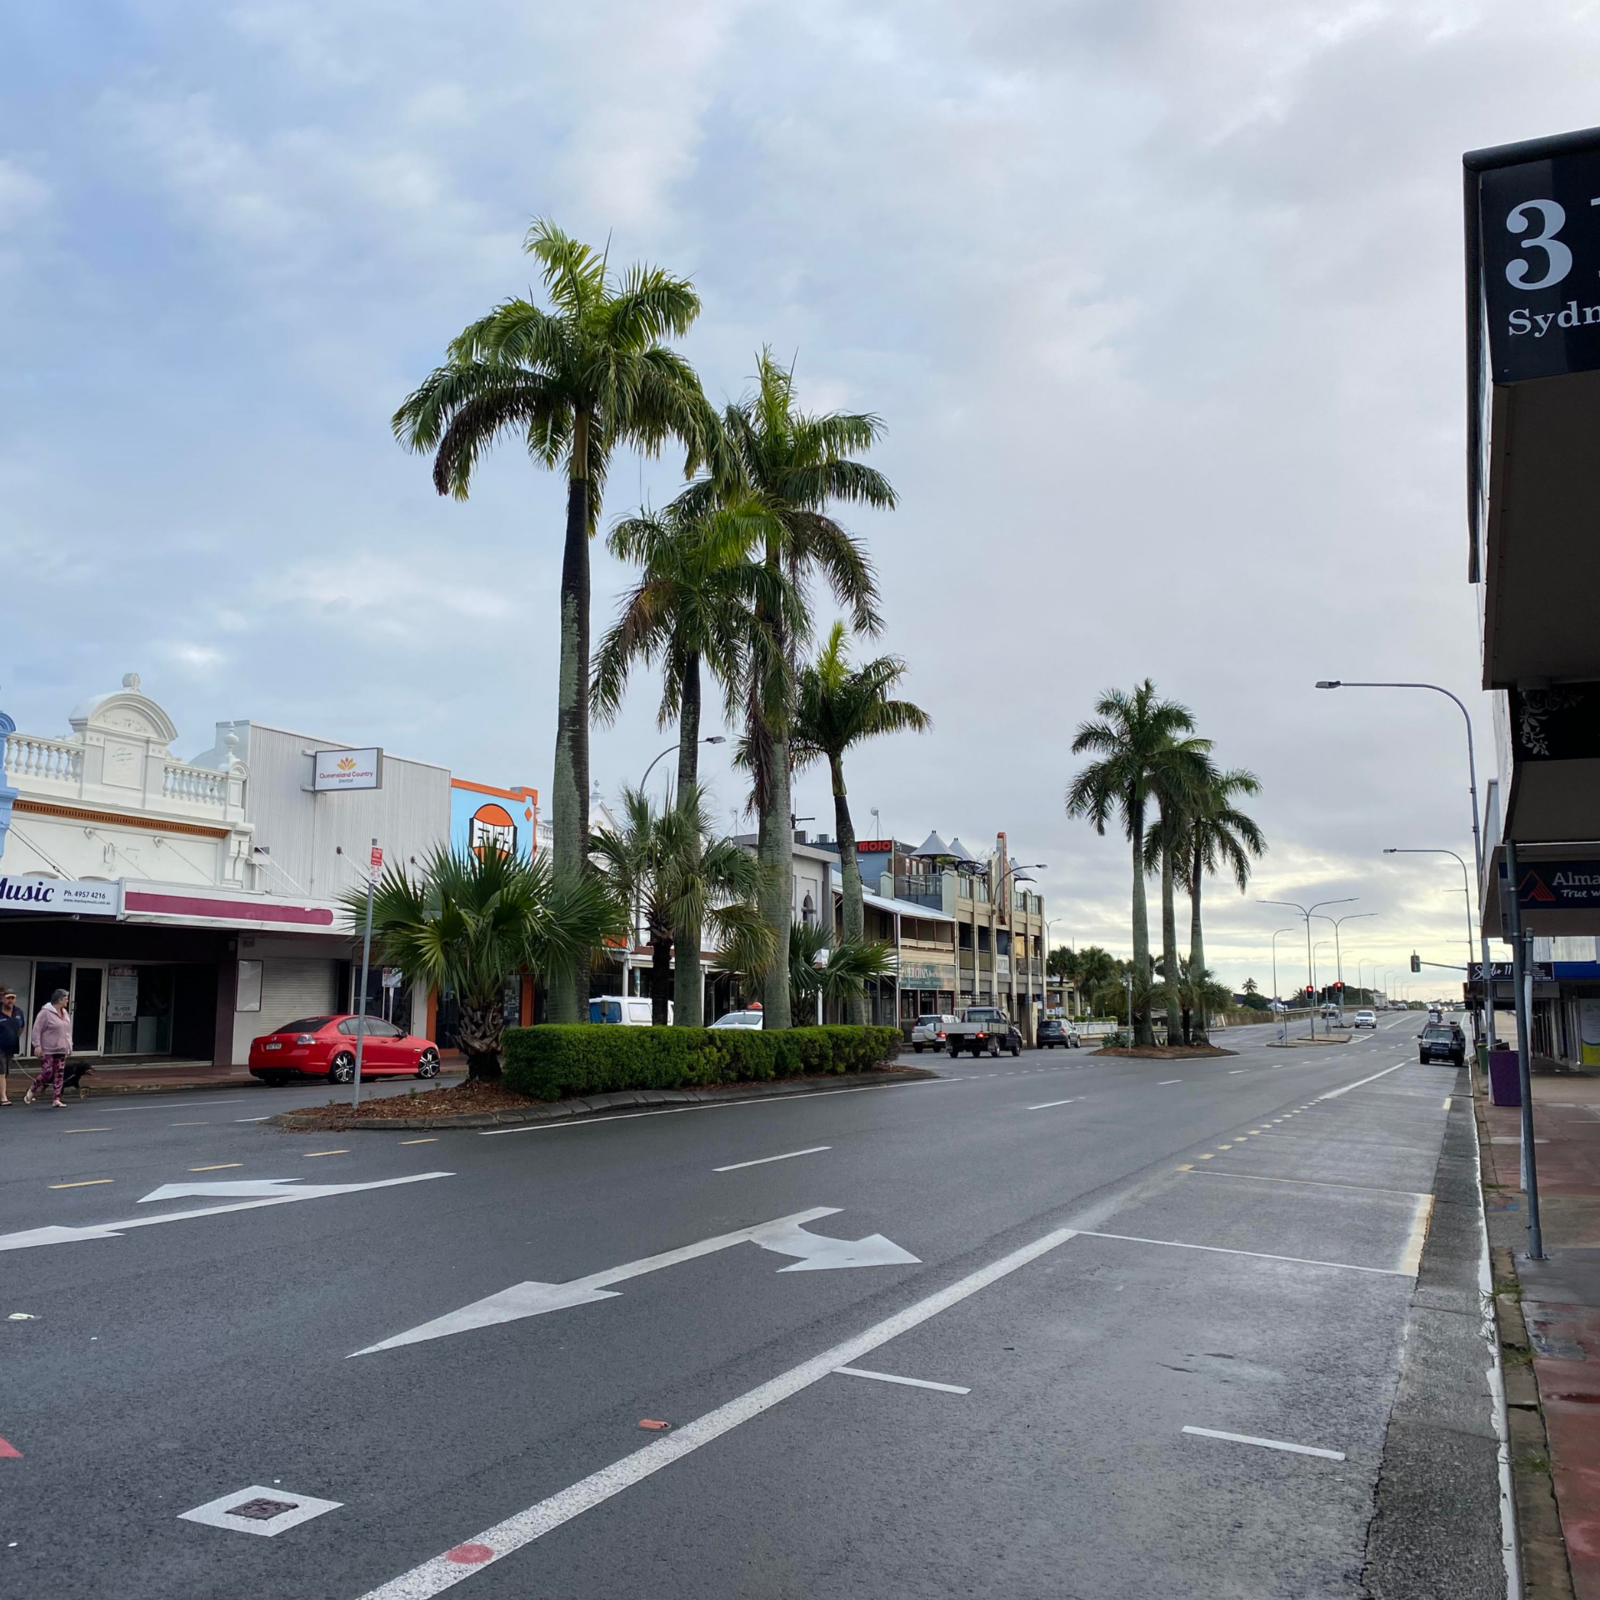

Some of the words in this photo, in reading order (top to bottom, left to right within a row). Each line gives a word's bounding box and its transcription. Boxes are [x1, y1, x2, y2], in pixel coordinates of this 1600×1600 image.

[74, 890, 90, 898] 4957
[1561, 889, 1588, 898] True
[1504, 964, 1512, 976] 11
